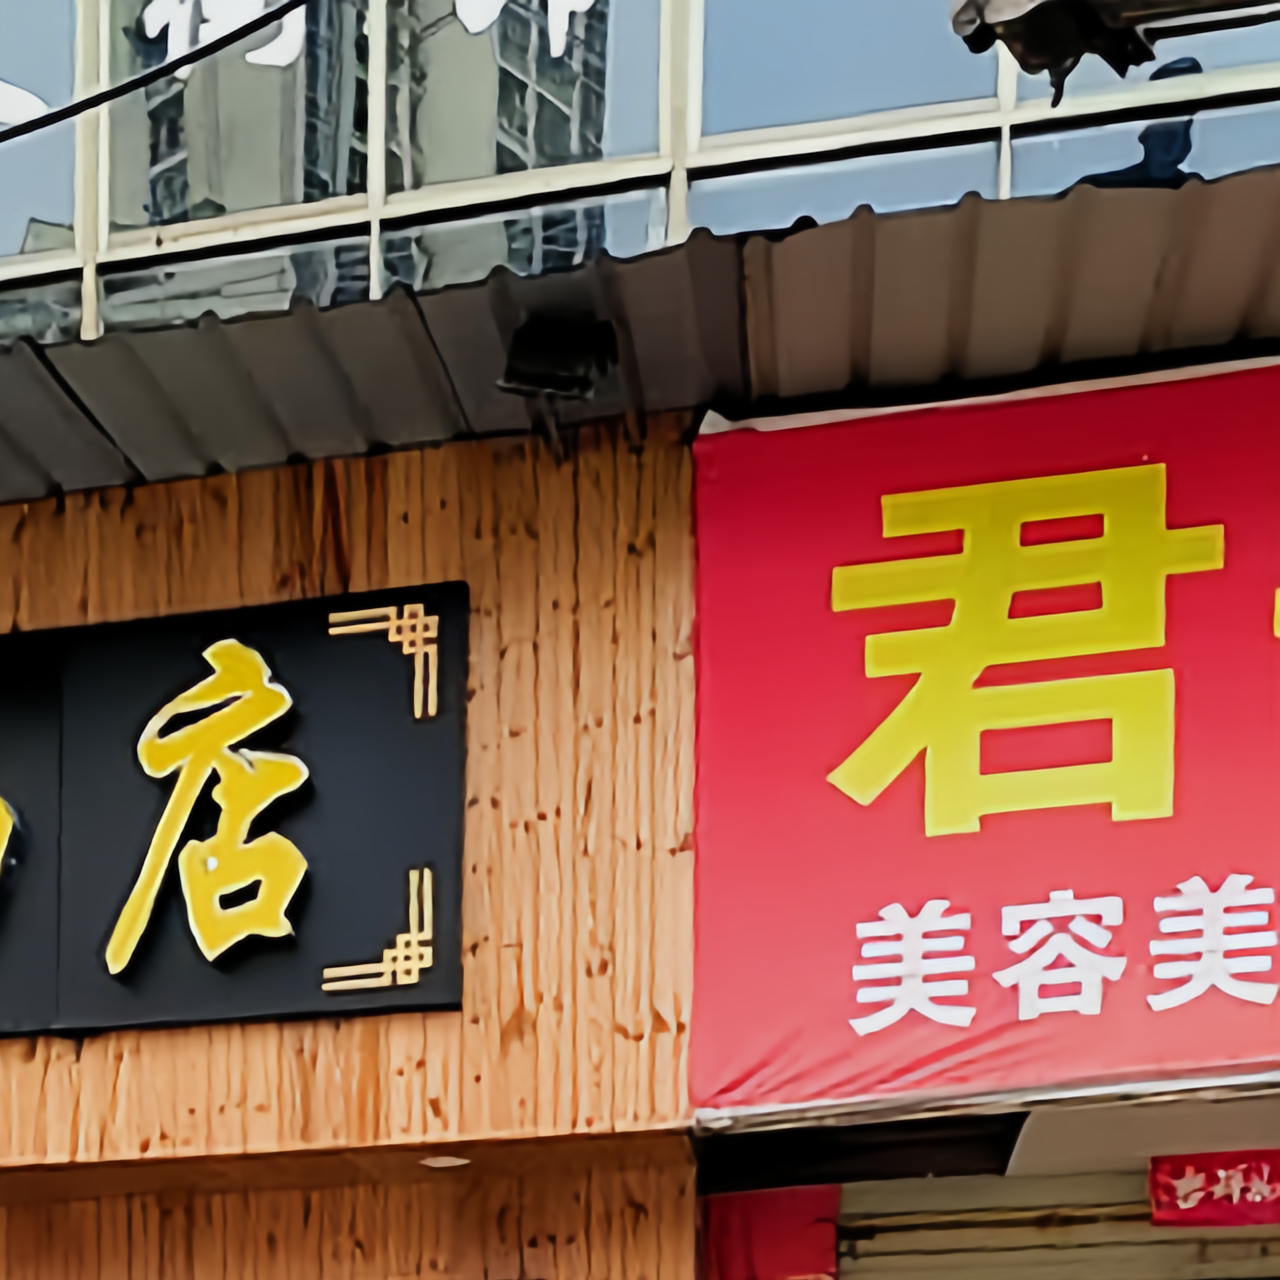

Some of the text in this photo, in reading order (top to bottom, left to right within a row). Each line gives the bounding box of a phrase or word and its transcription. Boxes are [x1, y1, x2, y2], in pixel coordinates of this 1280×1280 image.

[826, 462, 1280, 836] 君
[848, 873, 1280, 1036] 美容美
